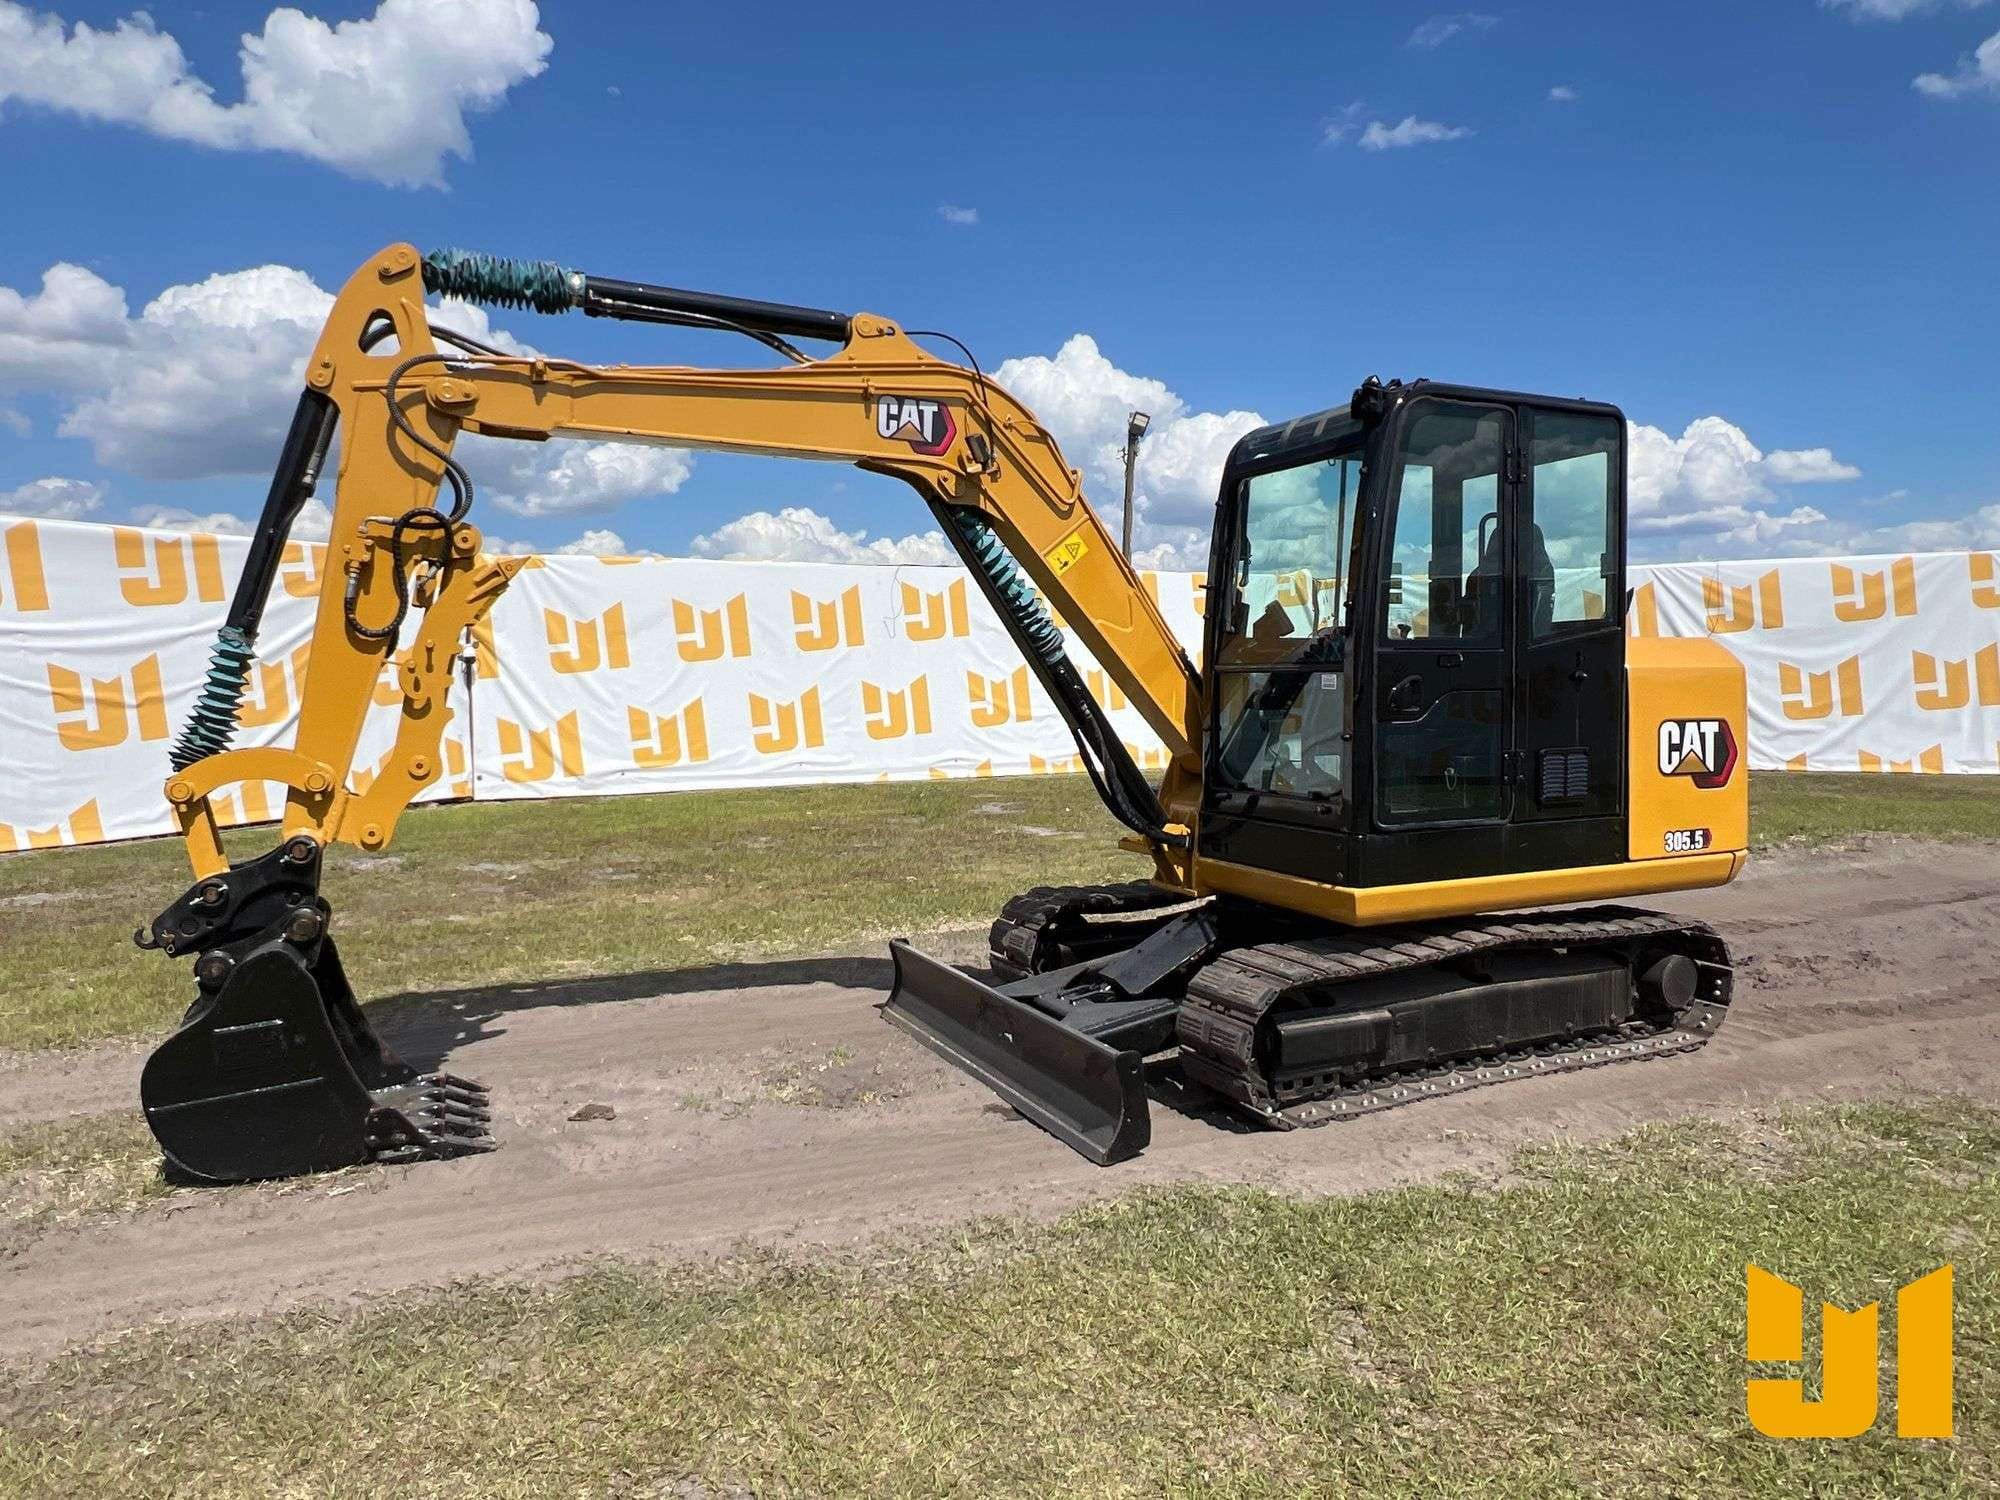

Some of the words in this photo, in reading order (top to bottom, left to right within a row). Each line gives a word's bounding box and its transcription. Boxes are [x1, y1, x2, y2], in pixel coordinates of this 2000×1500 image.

[878, 395, 938, 443] CAT
[1659, 720, 1720, 774] CAT
[1664, 829, 1704, 852] 305.5
